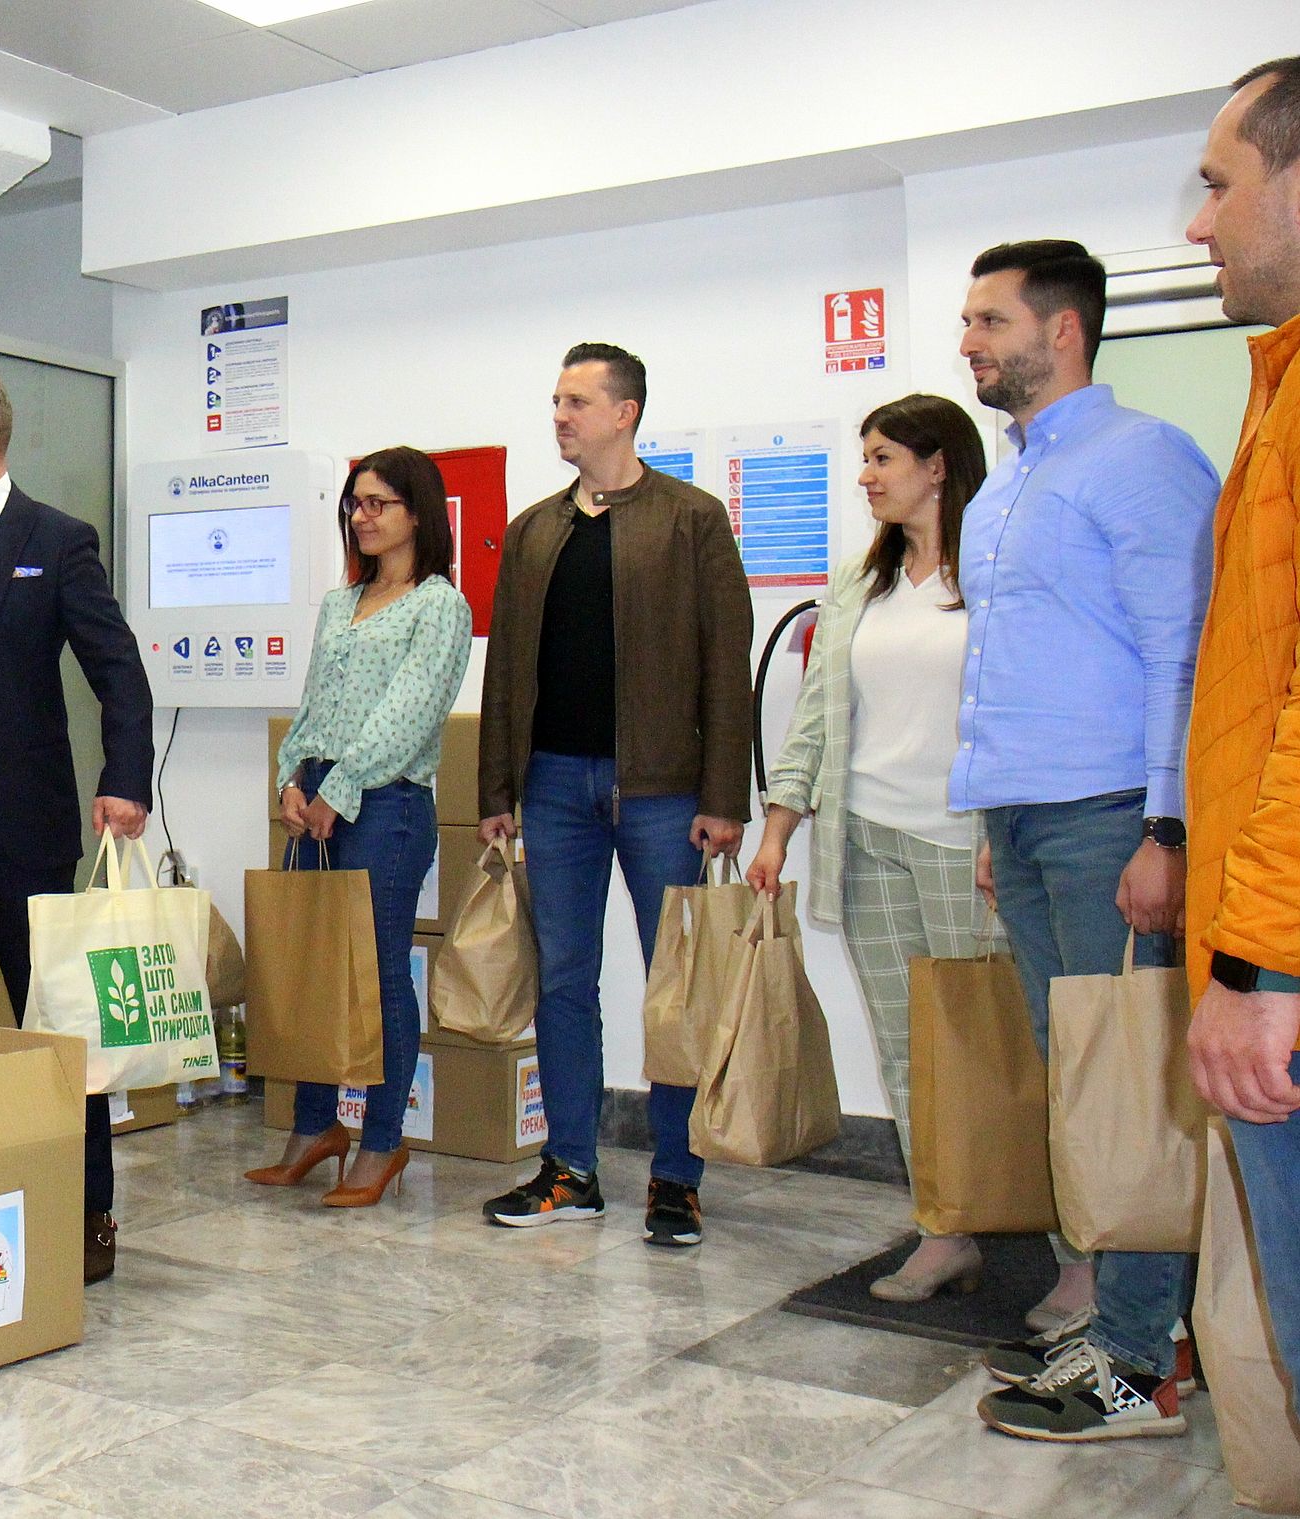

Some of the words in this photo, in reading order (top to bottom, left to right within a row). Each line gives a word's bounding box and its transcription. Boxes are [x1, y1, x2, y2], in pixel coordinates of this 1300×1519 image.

[189, 473, 270, 489] AlkaCanteen
[141, 943, 176, 967] ЗАТО
[145, 968, 175, 992] ШТО
[149, 995, 166, 1017] ЈА
